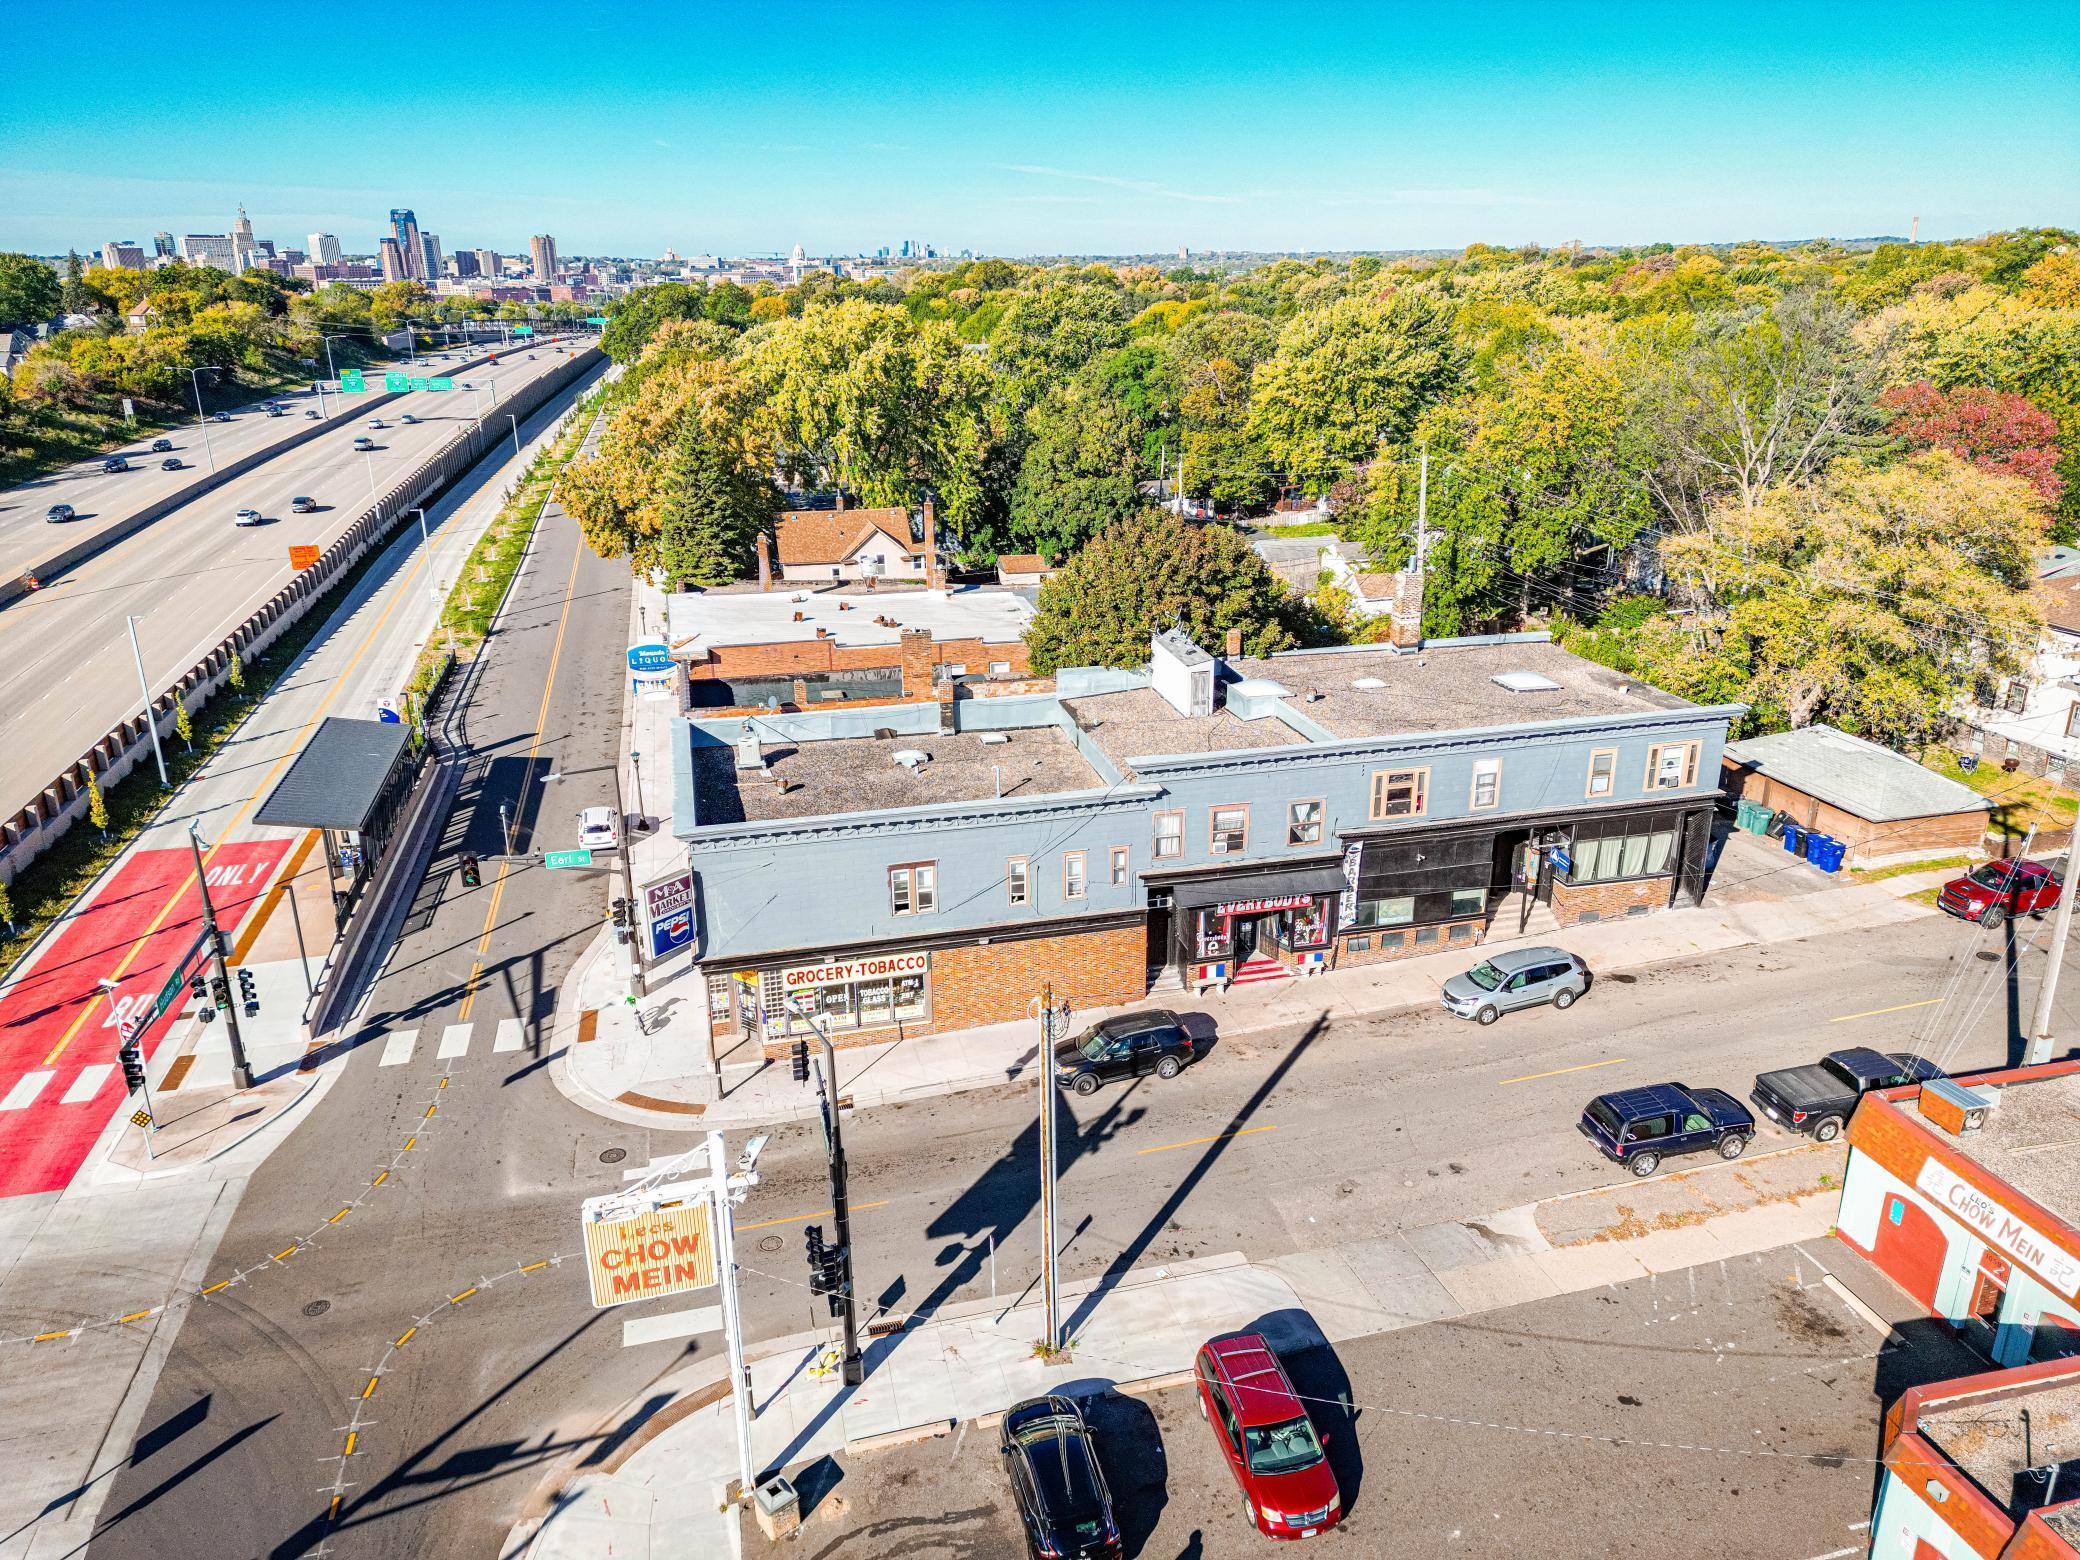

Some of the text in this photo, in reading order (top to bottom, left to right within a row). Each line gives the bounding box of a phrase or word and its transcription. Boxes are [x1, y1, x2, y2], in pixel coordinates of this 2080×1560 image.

[631, 656, 666, 665] LIQUO
[551, 854, 572, 865] Earl
[205, 862, 270, 887] ONLY
[650, 891, 690, 919] MARKET
[656, 911, 690, 934] PEPSI
[826, 993, 849, 1004] OPEN
[860, 986, 889, 997] TOBACCO
[862, 995, 886, 1004] GLASS
[1949, 1183, 2045, 1266] CHOW MEIN
[601, 1232, 700, 1270] CHOW
[612, 1261, 695, 1294] MEIN
